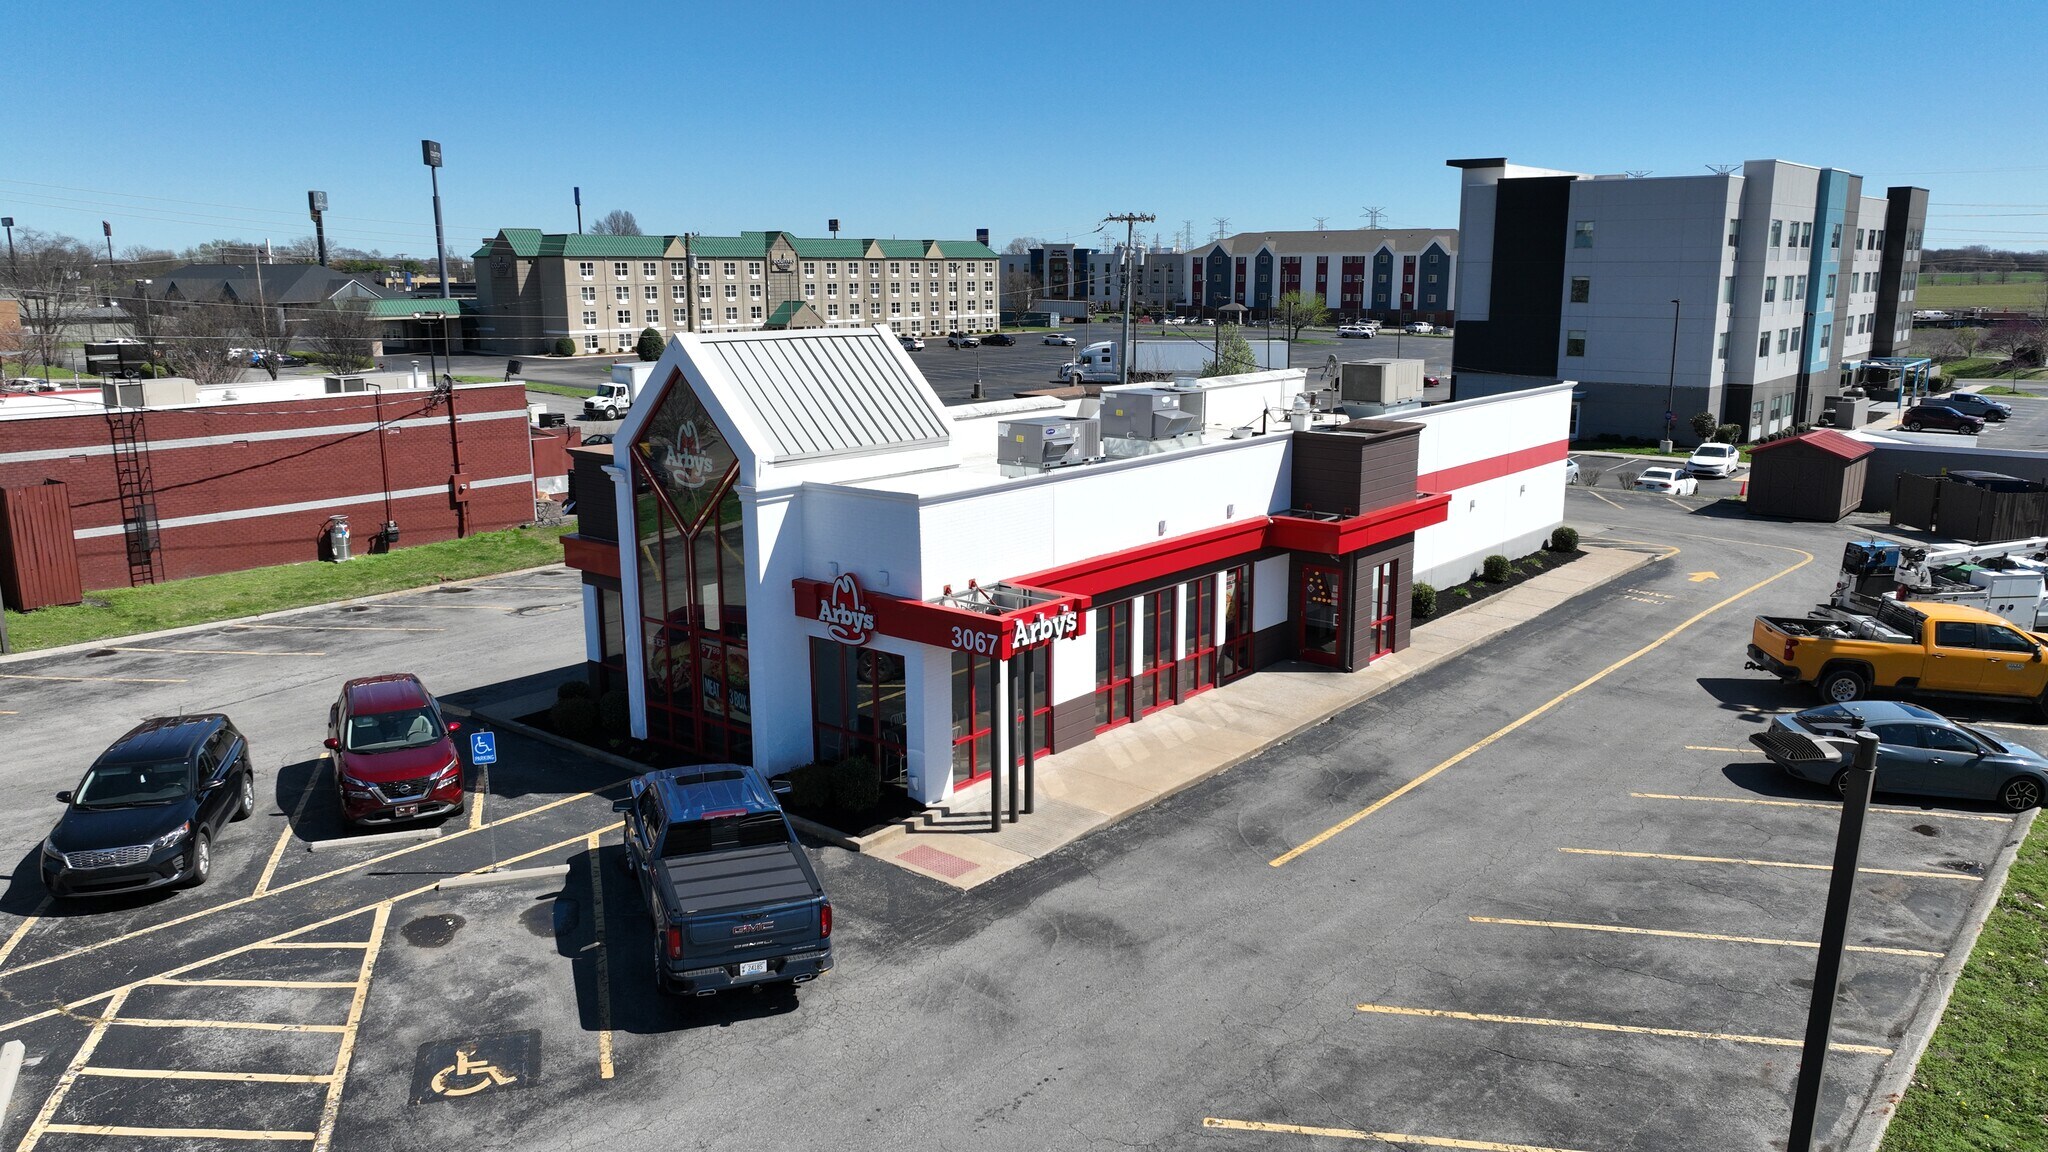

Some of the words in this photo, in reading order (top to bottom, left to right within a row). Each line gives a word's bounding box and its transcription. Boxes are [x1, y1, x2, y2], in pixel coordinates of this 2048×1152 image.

[665, 445, 713, 477] Arby's
[1624, 594, 1666, 605] THRU
[1628, 588, 1675, 598] DRIVE
[819, 599, 874, 634] Arby's
[1011, 604, 1077, 650] Arby's
[647, 634, 666, 648] BEEF
[951, 626, 998, 655] 3067
[704, 677, 720, 697] MEAT
[734, 691, 748, 712] BOX
[733, 920, 774, 934] GMC
